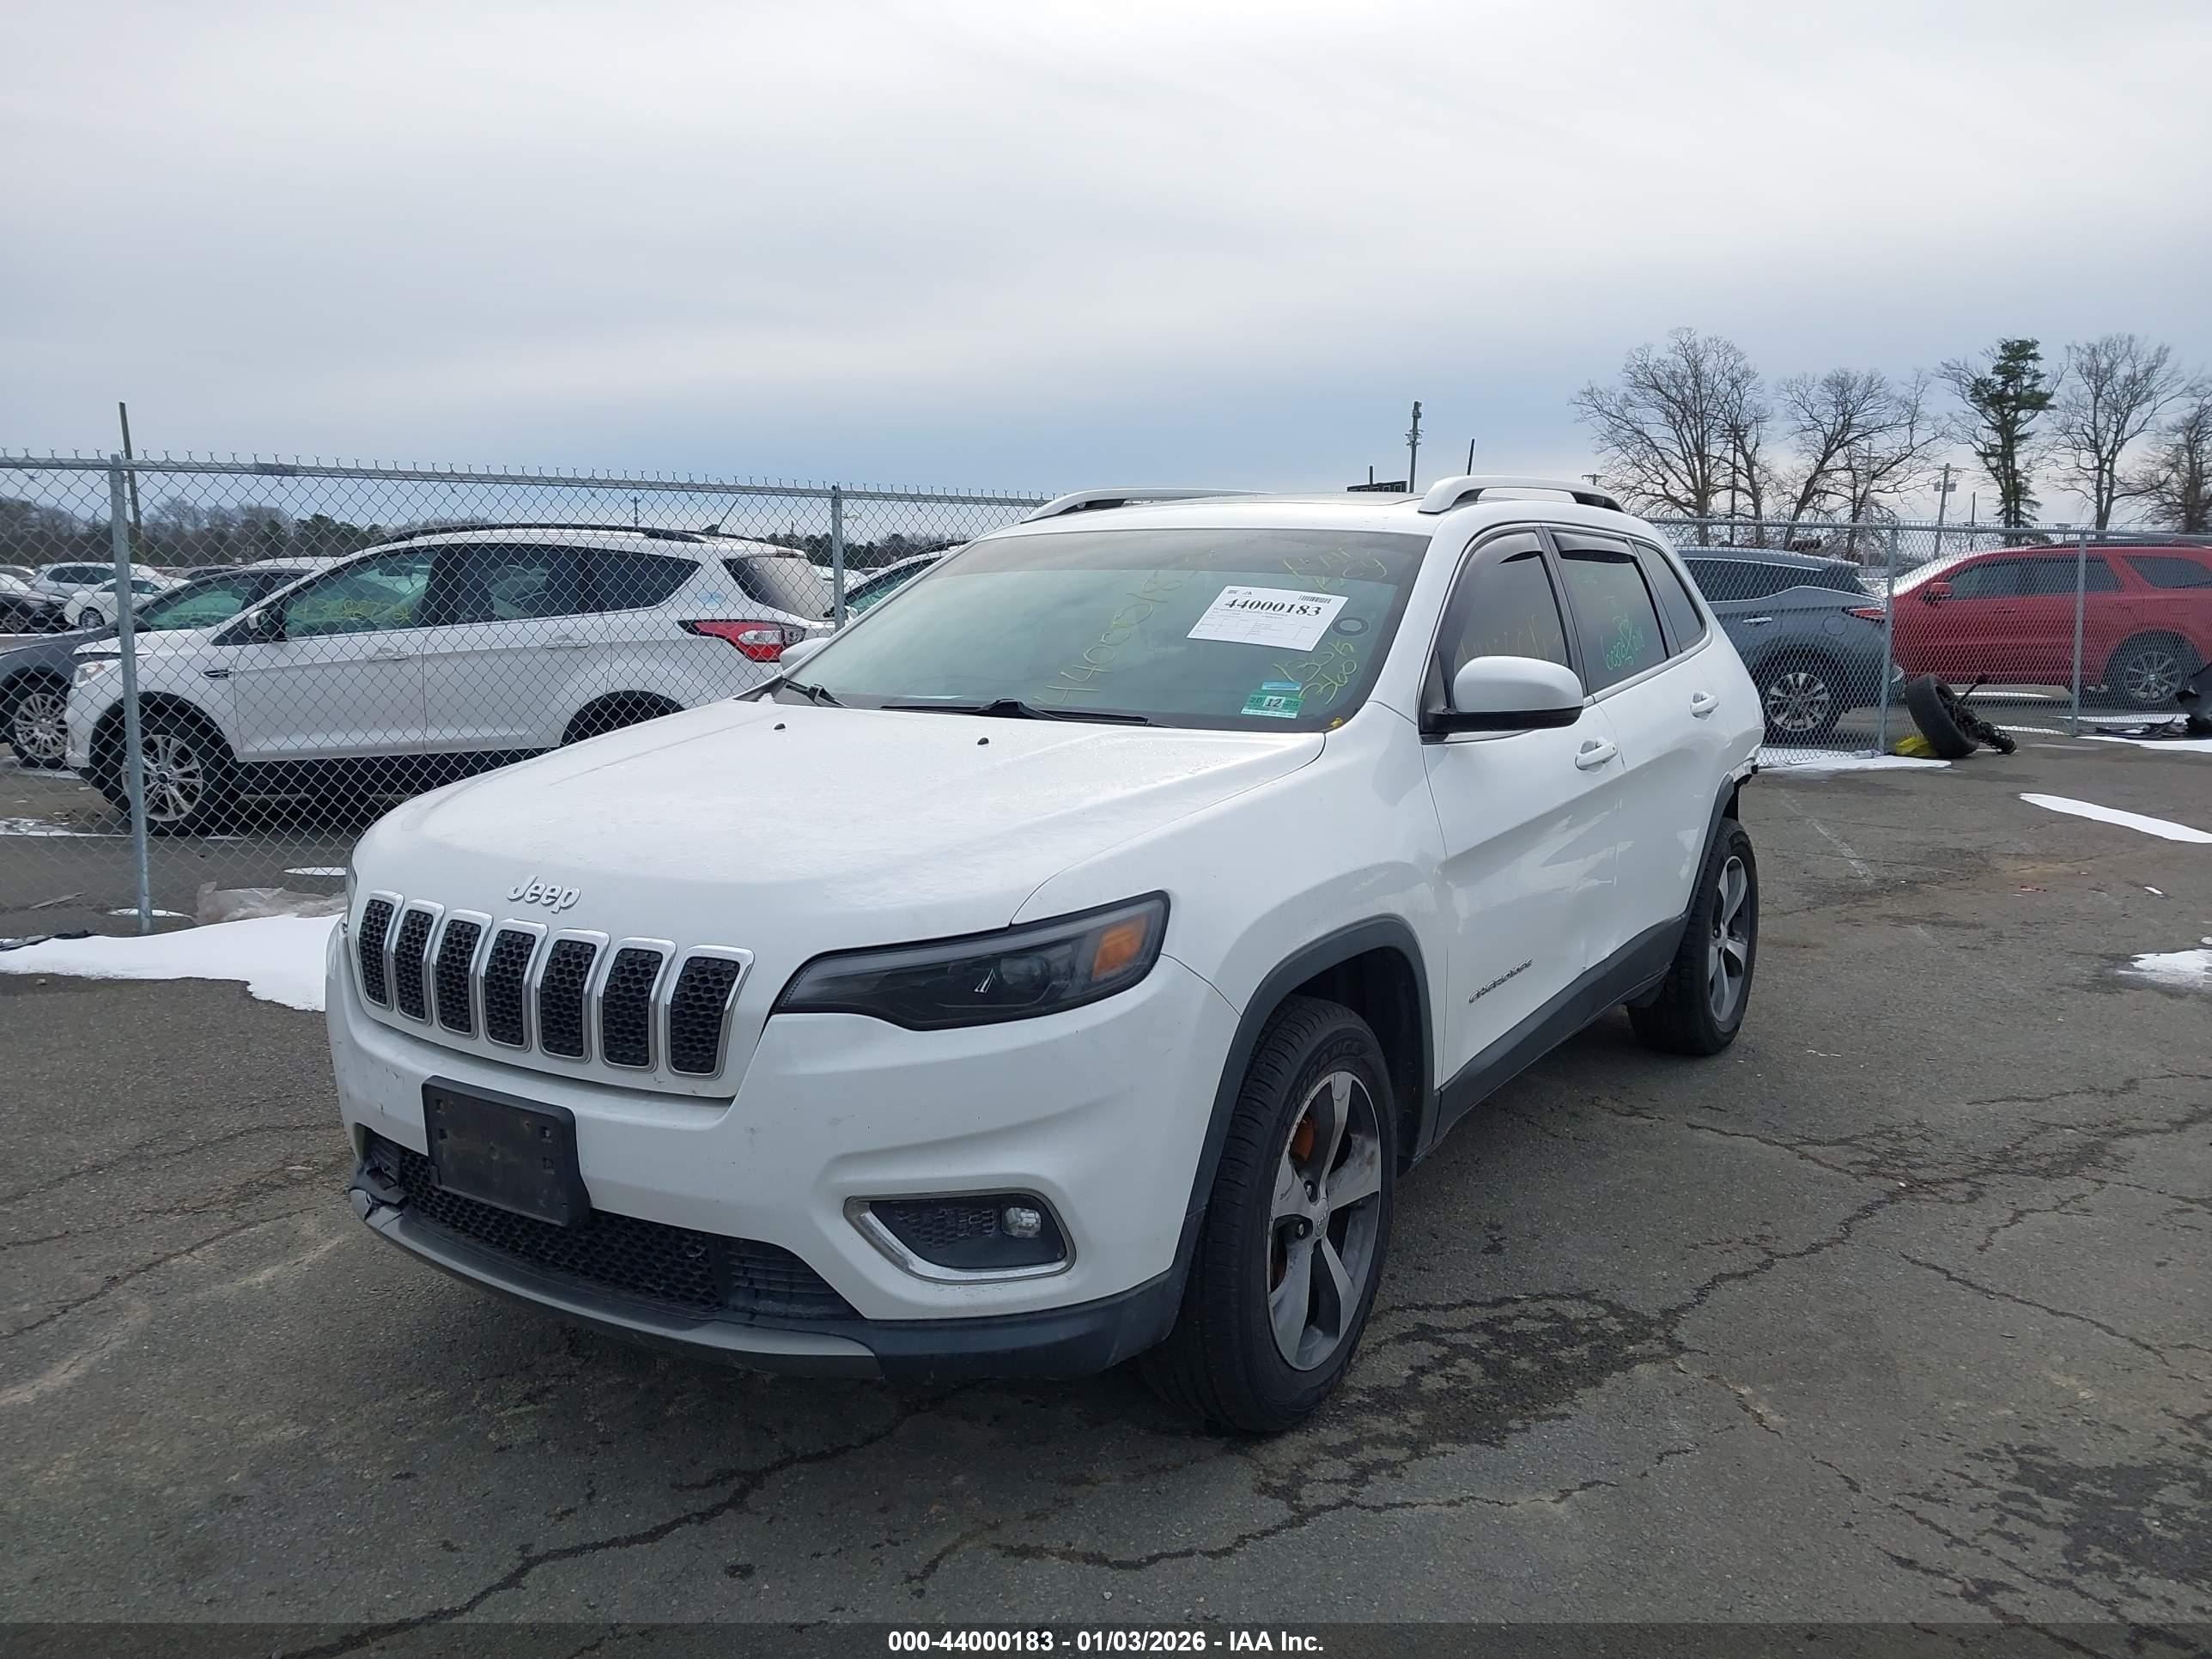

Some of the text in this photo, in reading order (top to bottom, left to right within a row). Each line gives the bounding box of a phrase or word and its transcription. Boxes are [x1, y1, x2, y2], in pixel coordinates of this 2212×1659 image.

[1224, 597, 1322, 617] 44000183
[1265, 697, 1282, 708] 12
[506, 875, 581, 915] Jeep
